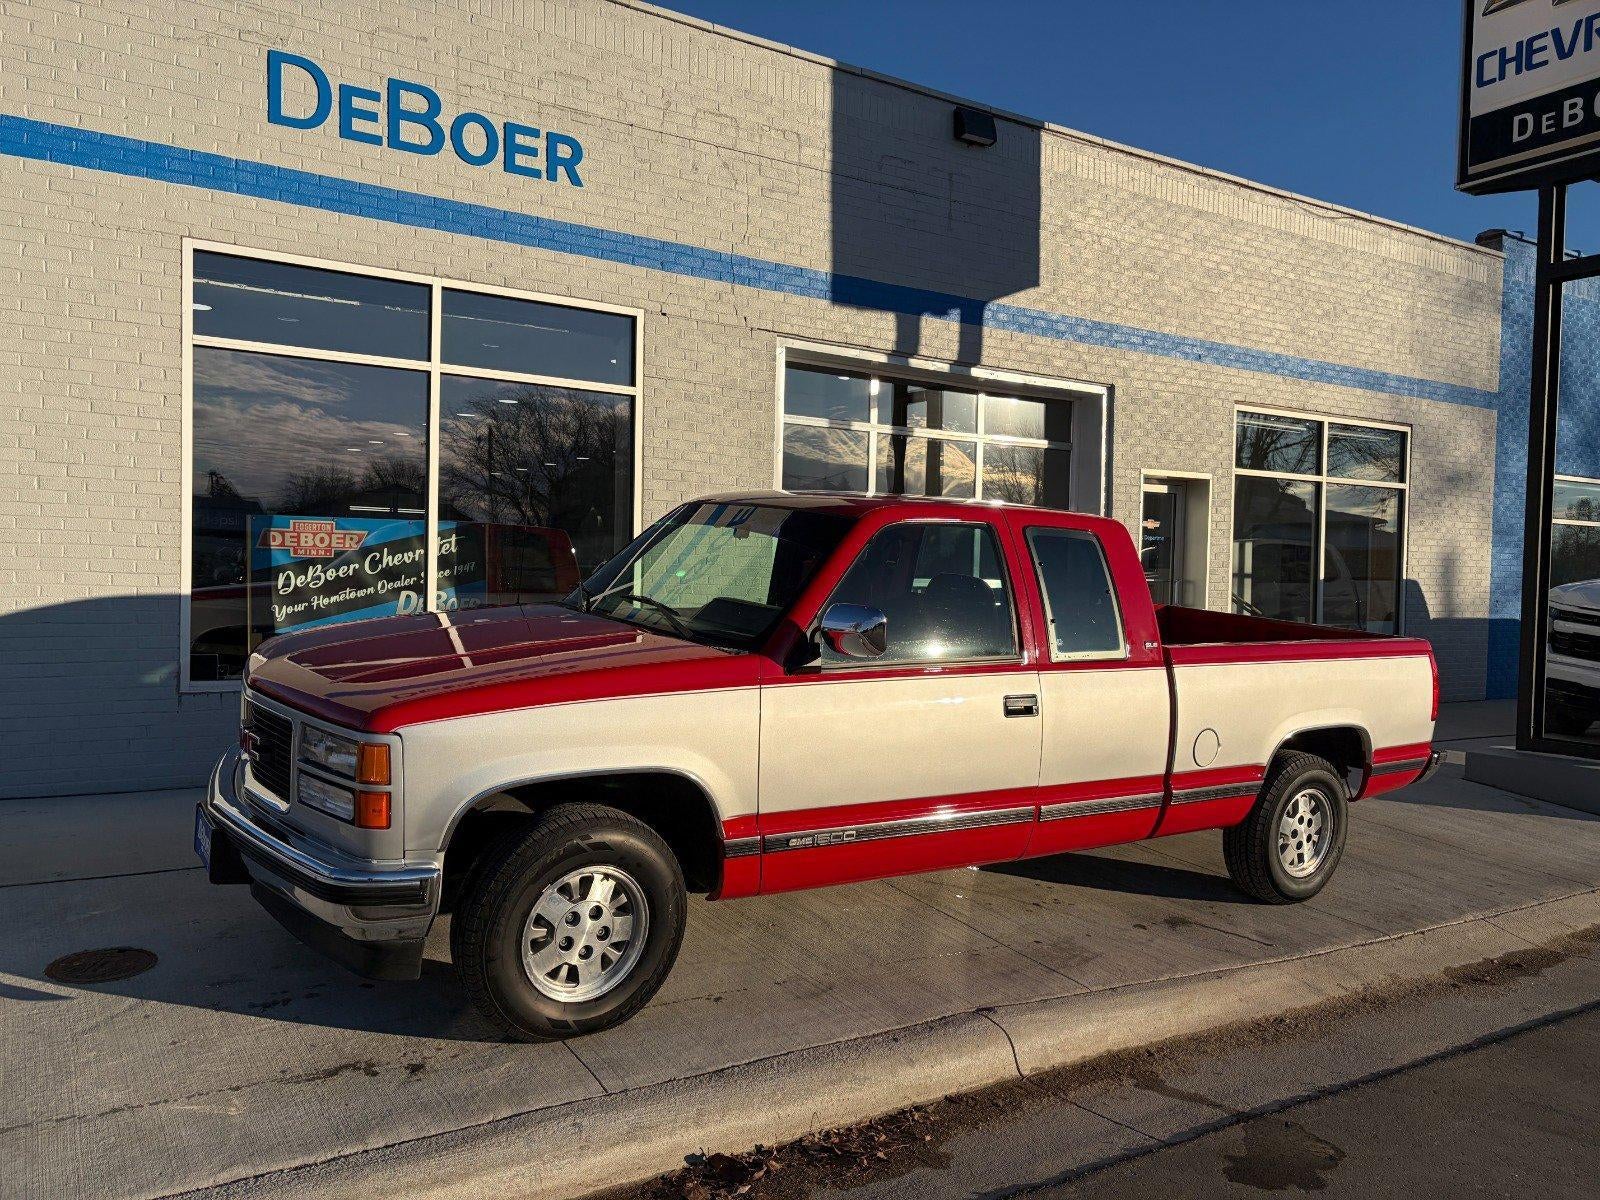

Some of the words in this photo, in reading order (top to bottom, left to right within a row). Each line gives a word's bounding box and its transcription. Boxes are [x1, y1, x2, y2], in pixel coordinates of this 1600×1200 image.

[270, 531, 359, 548] DEBOER
[297, 548, 330, 556] MINN.
[277, 563, 360, 595] DeBoer
[364, 533, 466, 575] Chevrlet
[271, 602, 309, 622] Your
[310, 587, 376, 610] Hometown
[377, 574, 417, 594] Dealer
